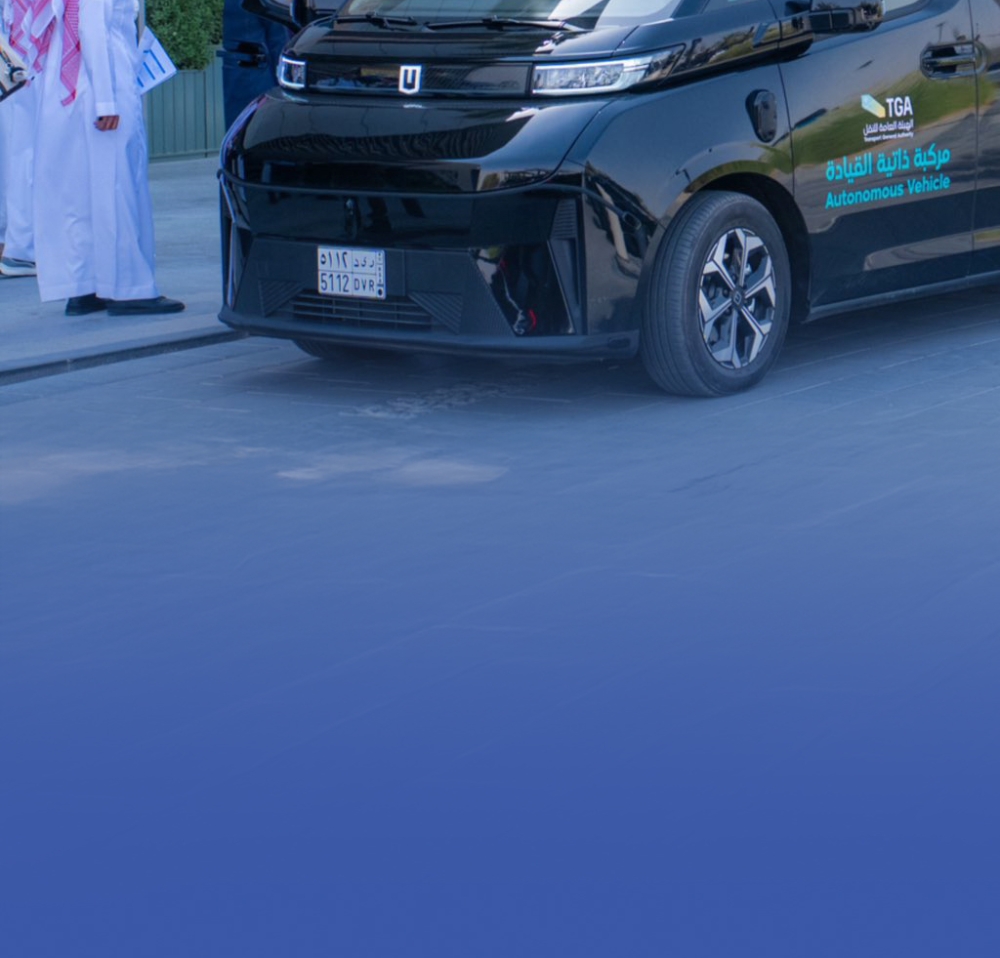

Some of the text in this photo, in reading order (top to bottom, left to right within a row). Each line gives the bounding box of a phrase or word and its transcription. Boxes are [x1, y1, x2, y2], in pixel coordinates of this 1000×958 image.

[886, 95, 914, 118] TGA
[825, 143, 951, 184] مركبة ذاتية القيادة
[825, 173, 951, 210] Autonomous Vehicle
[321, 273, 375, 293] 5112 DVR
